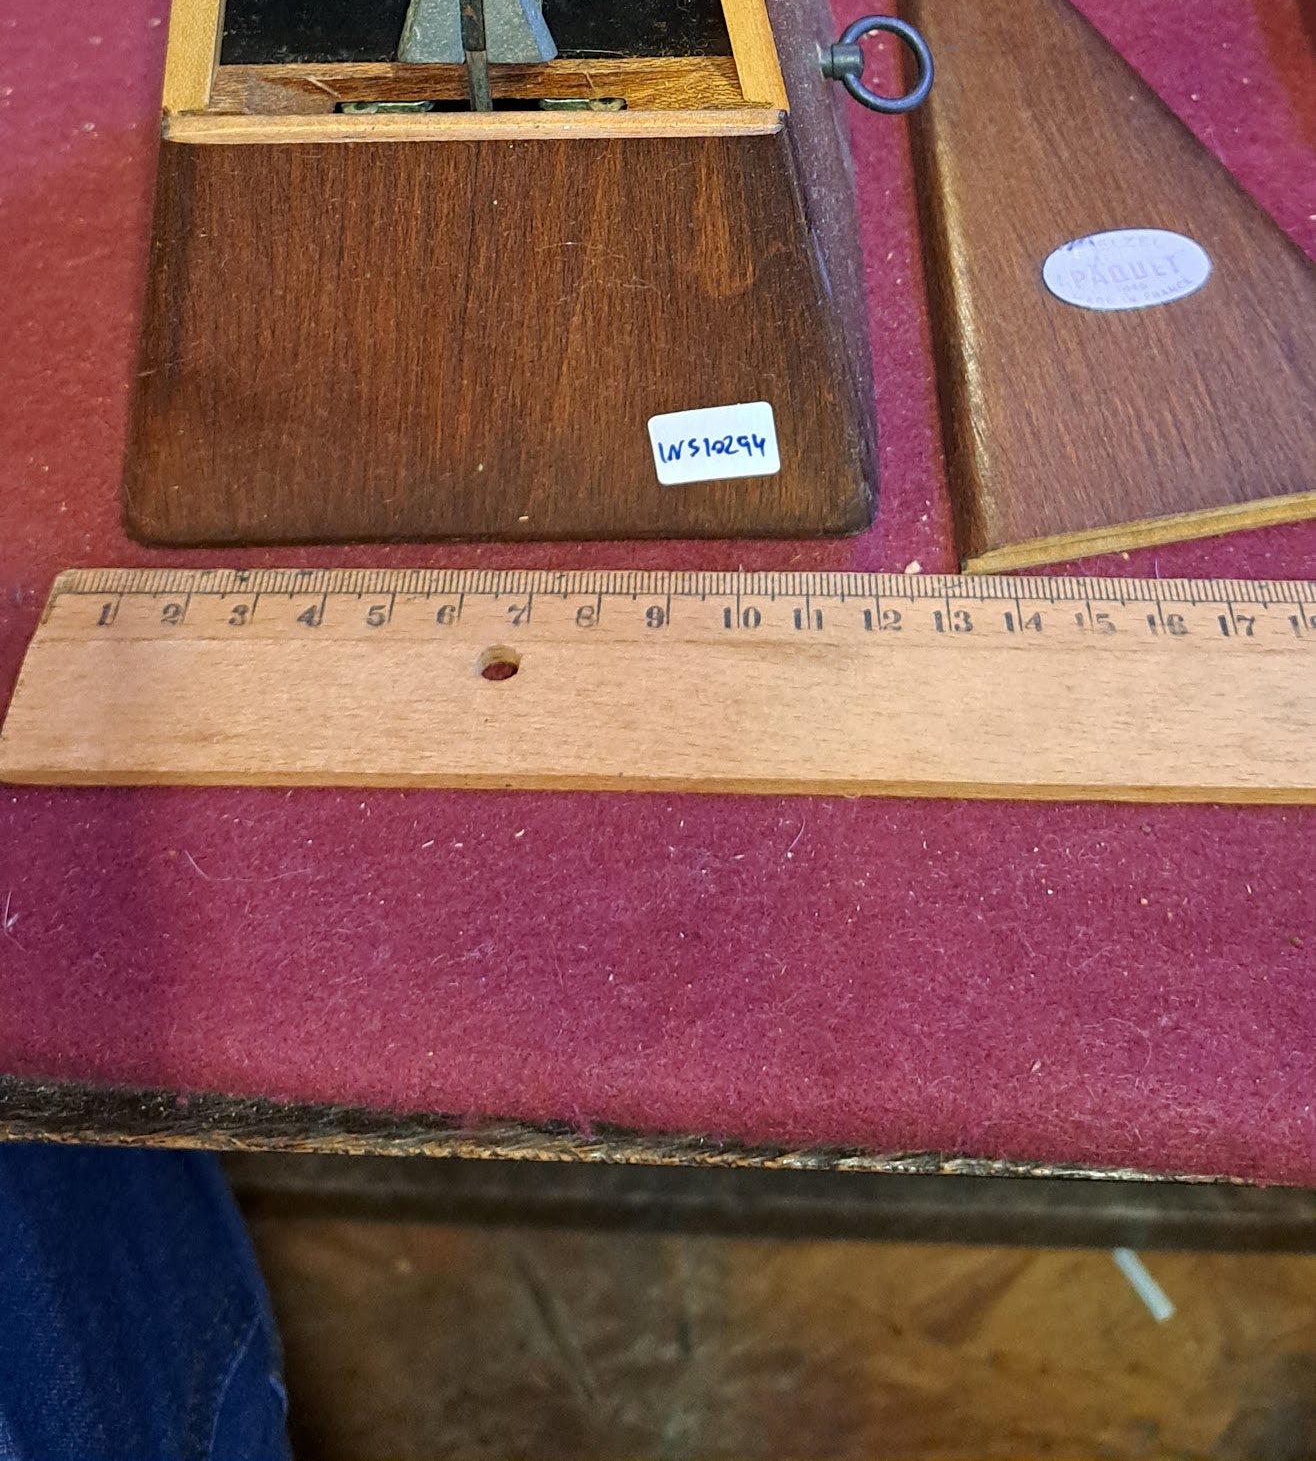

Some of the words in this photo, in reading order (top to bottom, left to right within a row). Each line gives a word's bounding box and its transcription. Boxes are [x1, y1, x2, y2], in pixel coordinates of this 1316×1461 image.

[98, 603, 113, 626] 1
[161, 603, 183, 626] 2
[228, 603, 249, 627] 3
[296, 603, 322, 627] 4
[366, 603, 387, 627] 5
[436, 604, 457, 627] 6
[507, 604, 527, 627] 7
[575, 605, 597, 628] 8
[645, 605, 666, 629] 9
[723, 606, 762, 630] 10
[793, 608, 824, 631] 11
[863, 608, 902, 632] 12
[933, 610, 973, 633] 13
[1004, 610, 1043, 633] 14
[1075, 611, 1116, 635] 15
[1146, 613, 1188, 636] 16
[1217, 614, 1256, 637] 17
